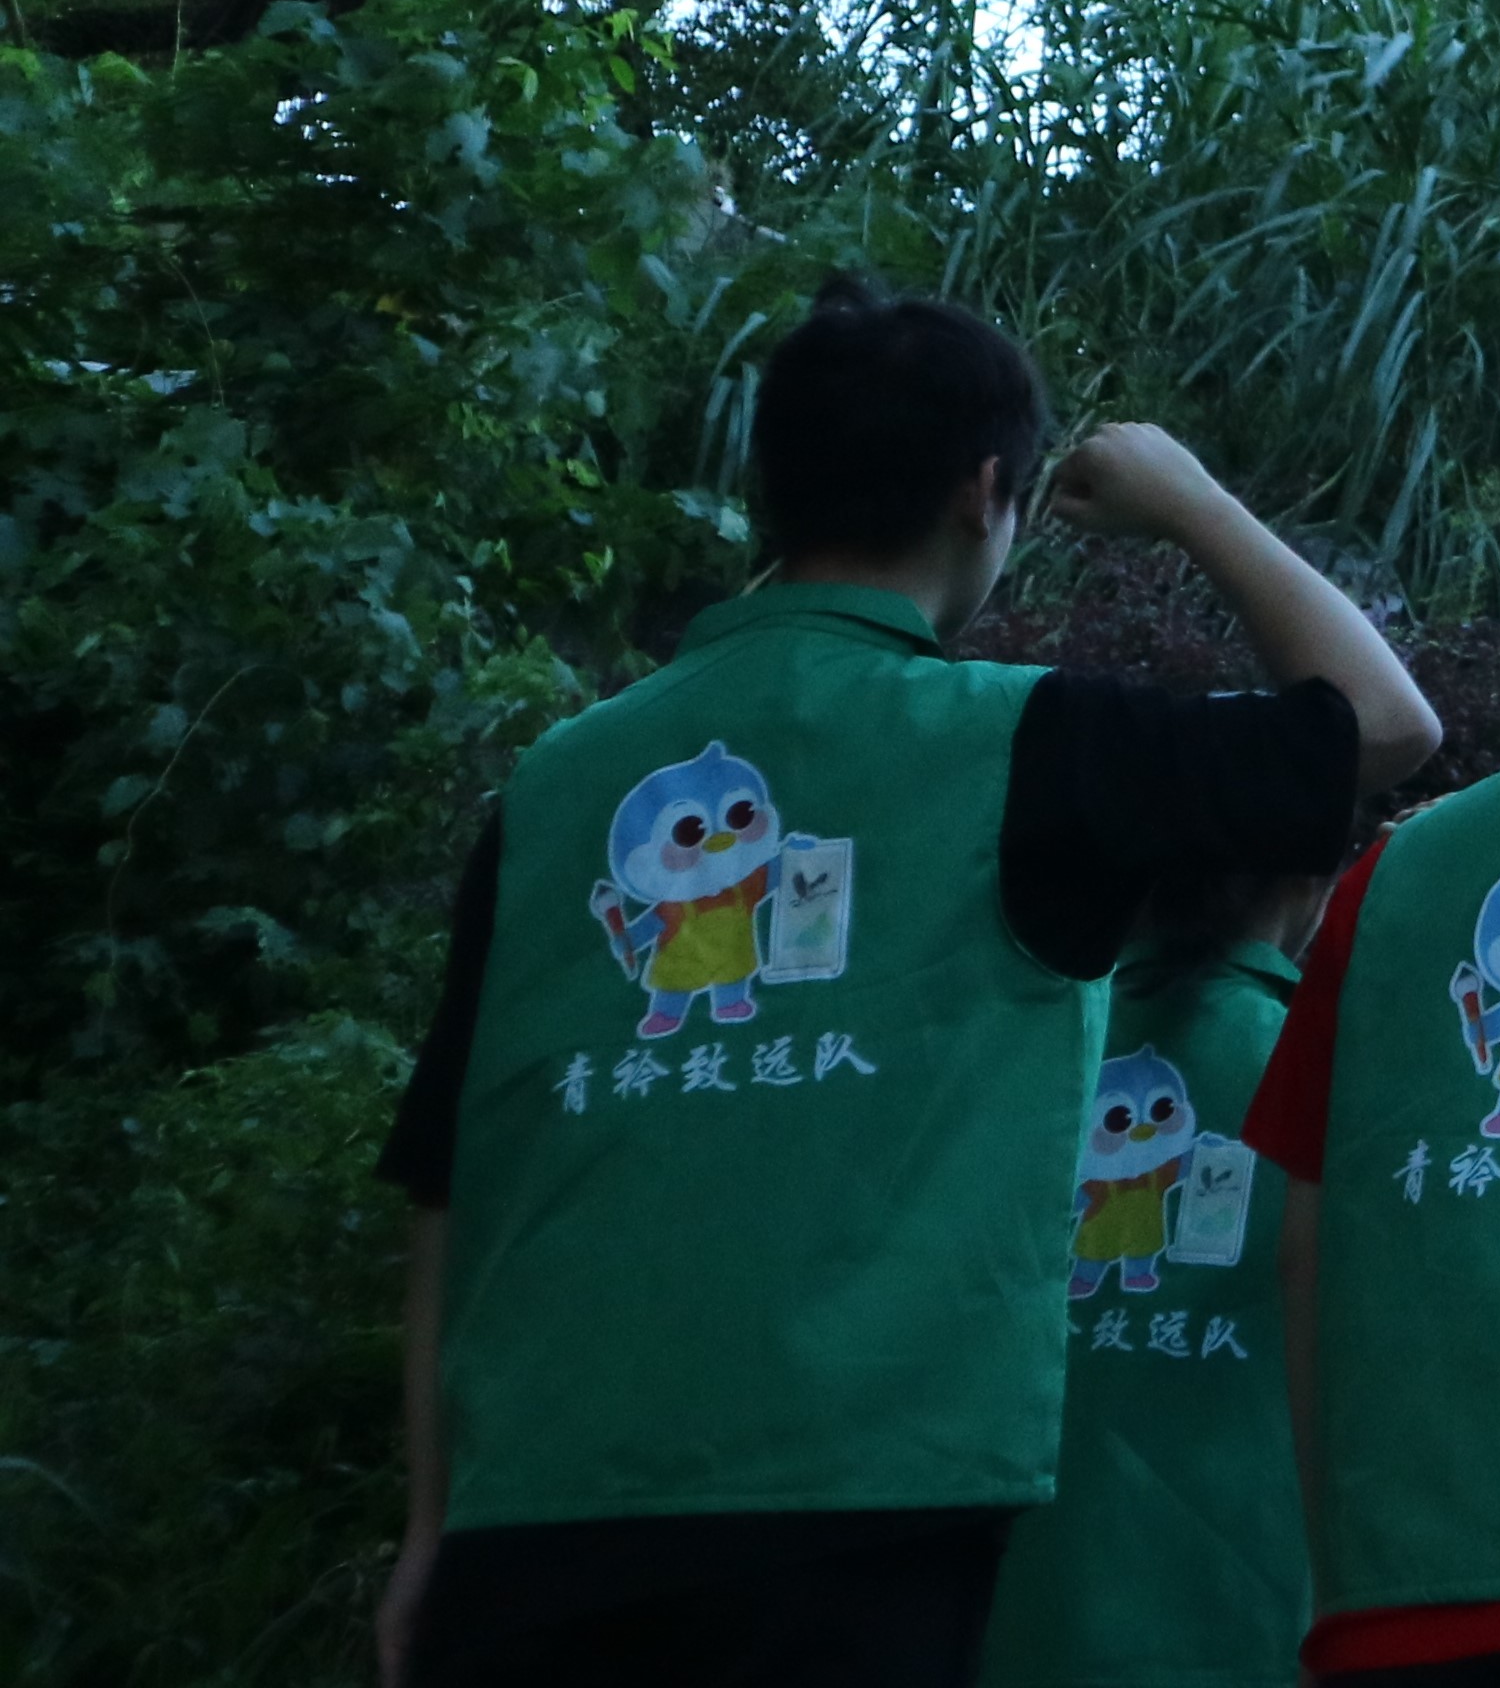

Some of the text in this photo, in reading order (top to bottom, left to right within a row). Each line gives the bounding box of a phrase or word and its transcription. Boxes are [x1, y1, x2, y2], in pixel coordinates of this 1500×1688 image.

[552, 1031, 876, 1114] 青衿致远队
[1067, 1308, 1248, 1360] 致远队
